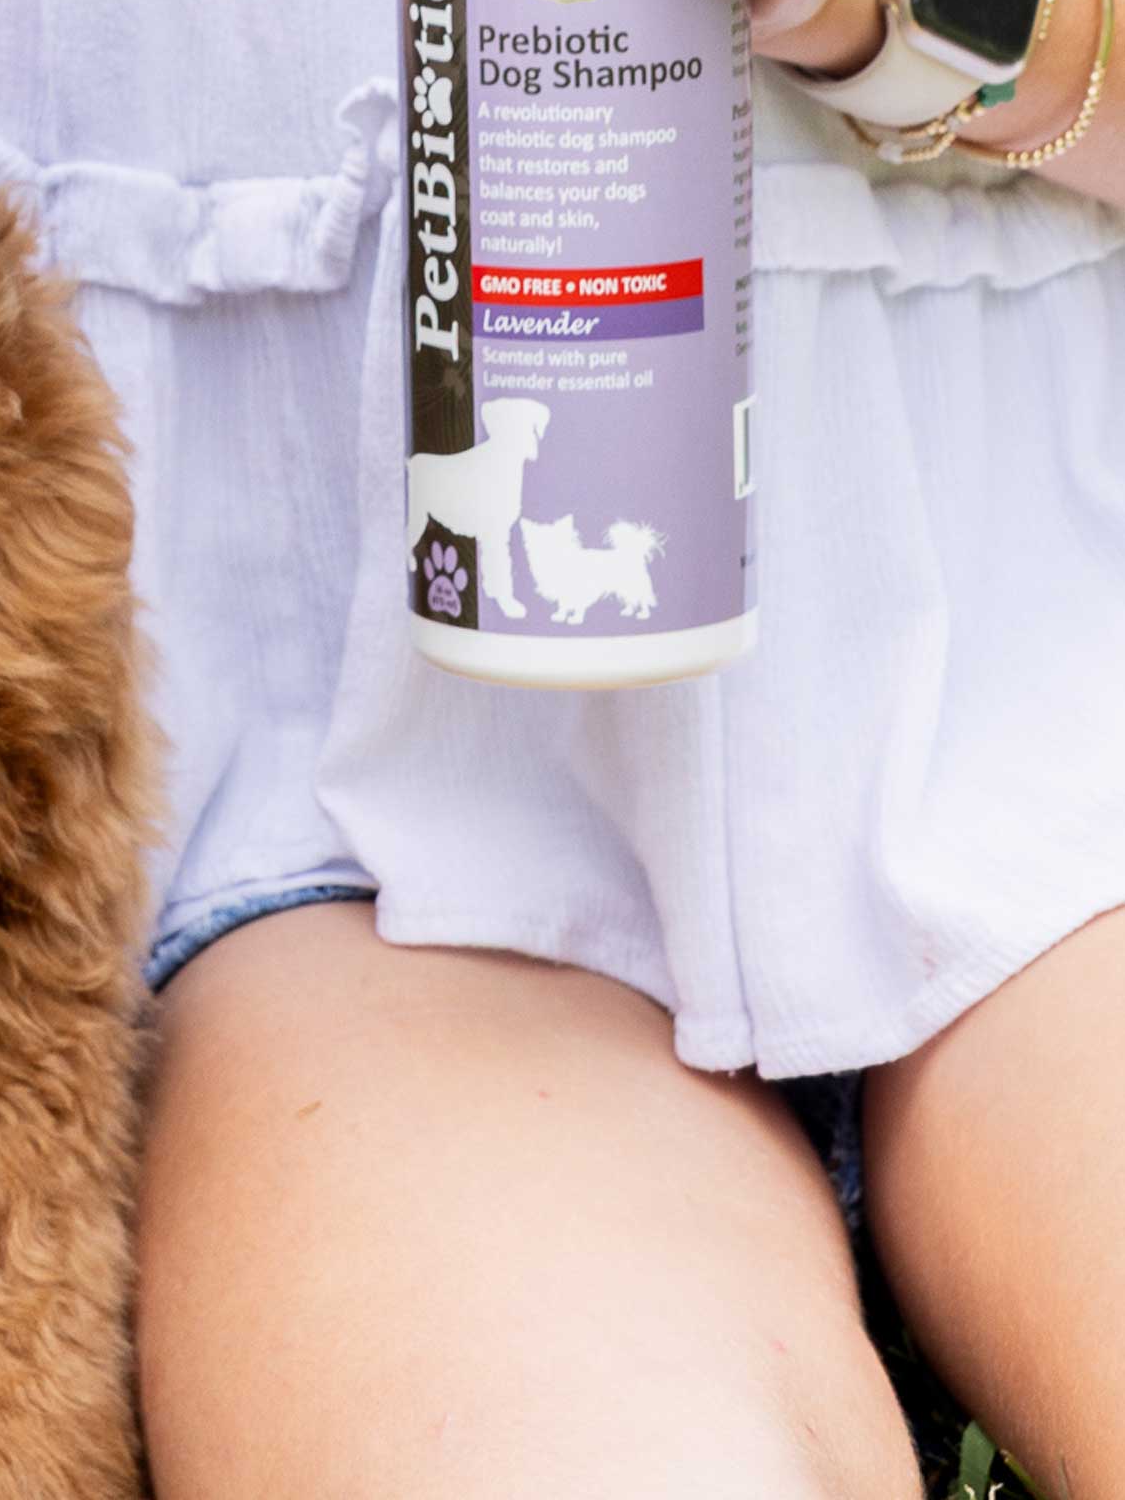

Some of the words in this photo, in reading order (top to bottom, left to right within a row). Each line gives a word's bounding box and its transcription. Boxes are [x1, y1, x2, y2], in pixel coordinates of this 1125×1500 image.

[478, 24, 629, 55] Prebiotic
[479, 58, 542, 96] Dog
[552, 56, 703, 92] Shampoo
[477, 101, 491, 119] A
[493, 103, 614, 125] revolutionary
[477, 129, 556, 149] prebiotic
[558, 130, 595, 152] dog
[598, 126, 677, 149] shampoo
[478, 154, 513, 174] that
[516, 157, 591, 176] restores
[594, 154, 629, 174] and
[479, 180, 555, 201] balances
[558, 185, 602, 205] your
[604, 182, 648, 203] dogs
[479, 208, 516, 227] coat
[519, 209, 554, 229] and
[558, 209, 601, 231] skin,
[480, 235, 563, 258] naturally!
[479, 275, 521, 294] GMO
[522, 276, 563, 297] FREE
[578, 276, 619, 297] NON
[620, 273, 668, 294] TOXIC
[482, 307, 601, 336] Lavender
[482, 346, 544, 366] Scented
[547, 348, 585, 367] with
[588, 351, 628, 370] pure
[482, 370, 554, 390] Lavender
[557, 372, 631, 392] essential
[633, 369, 654, 388] oil
